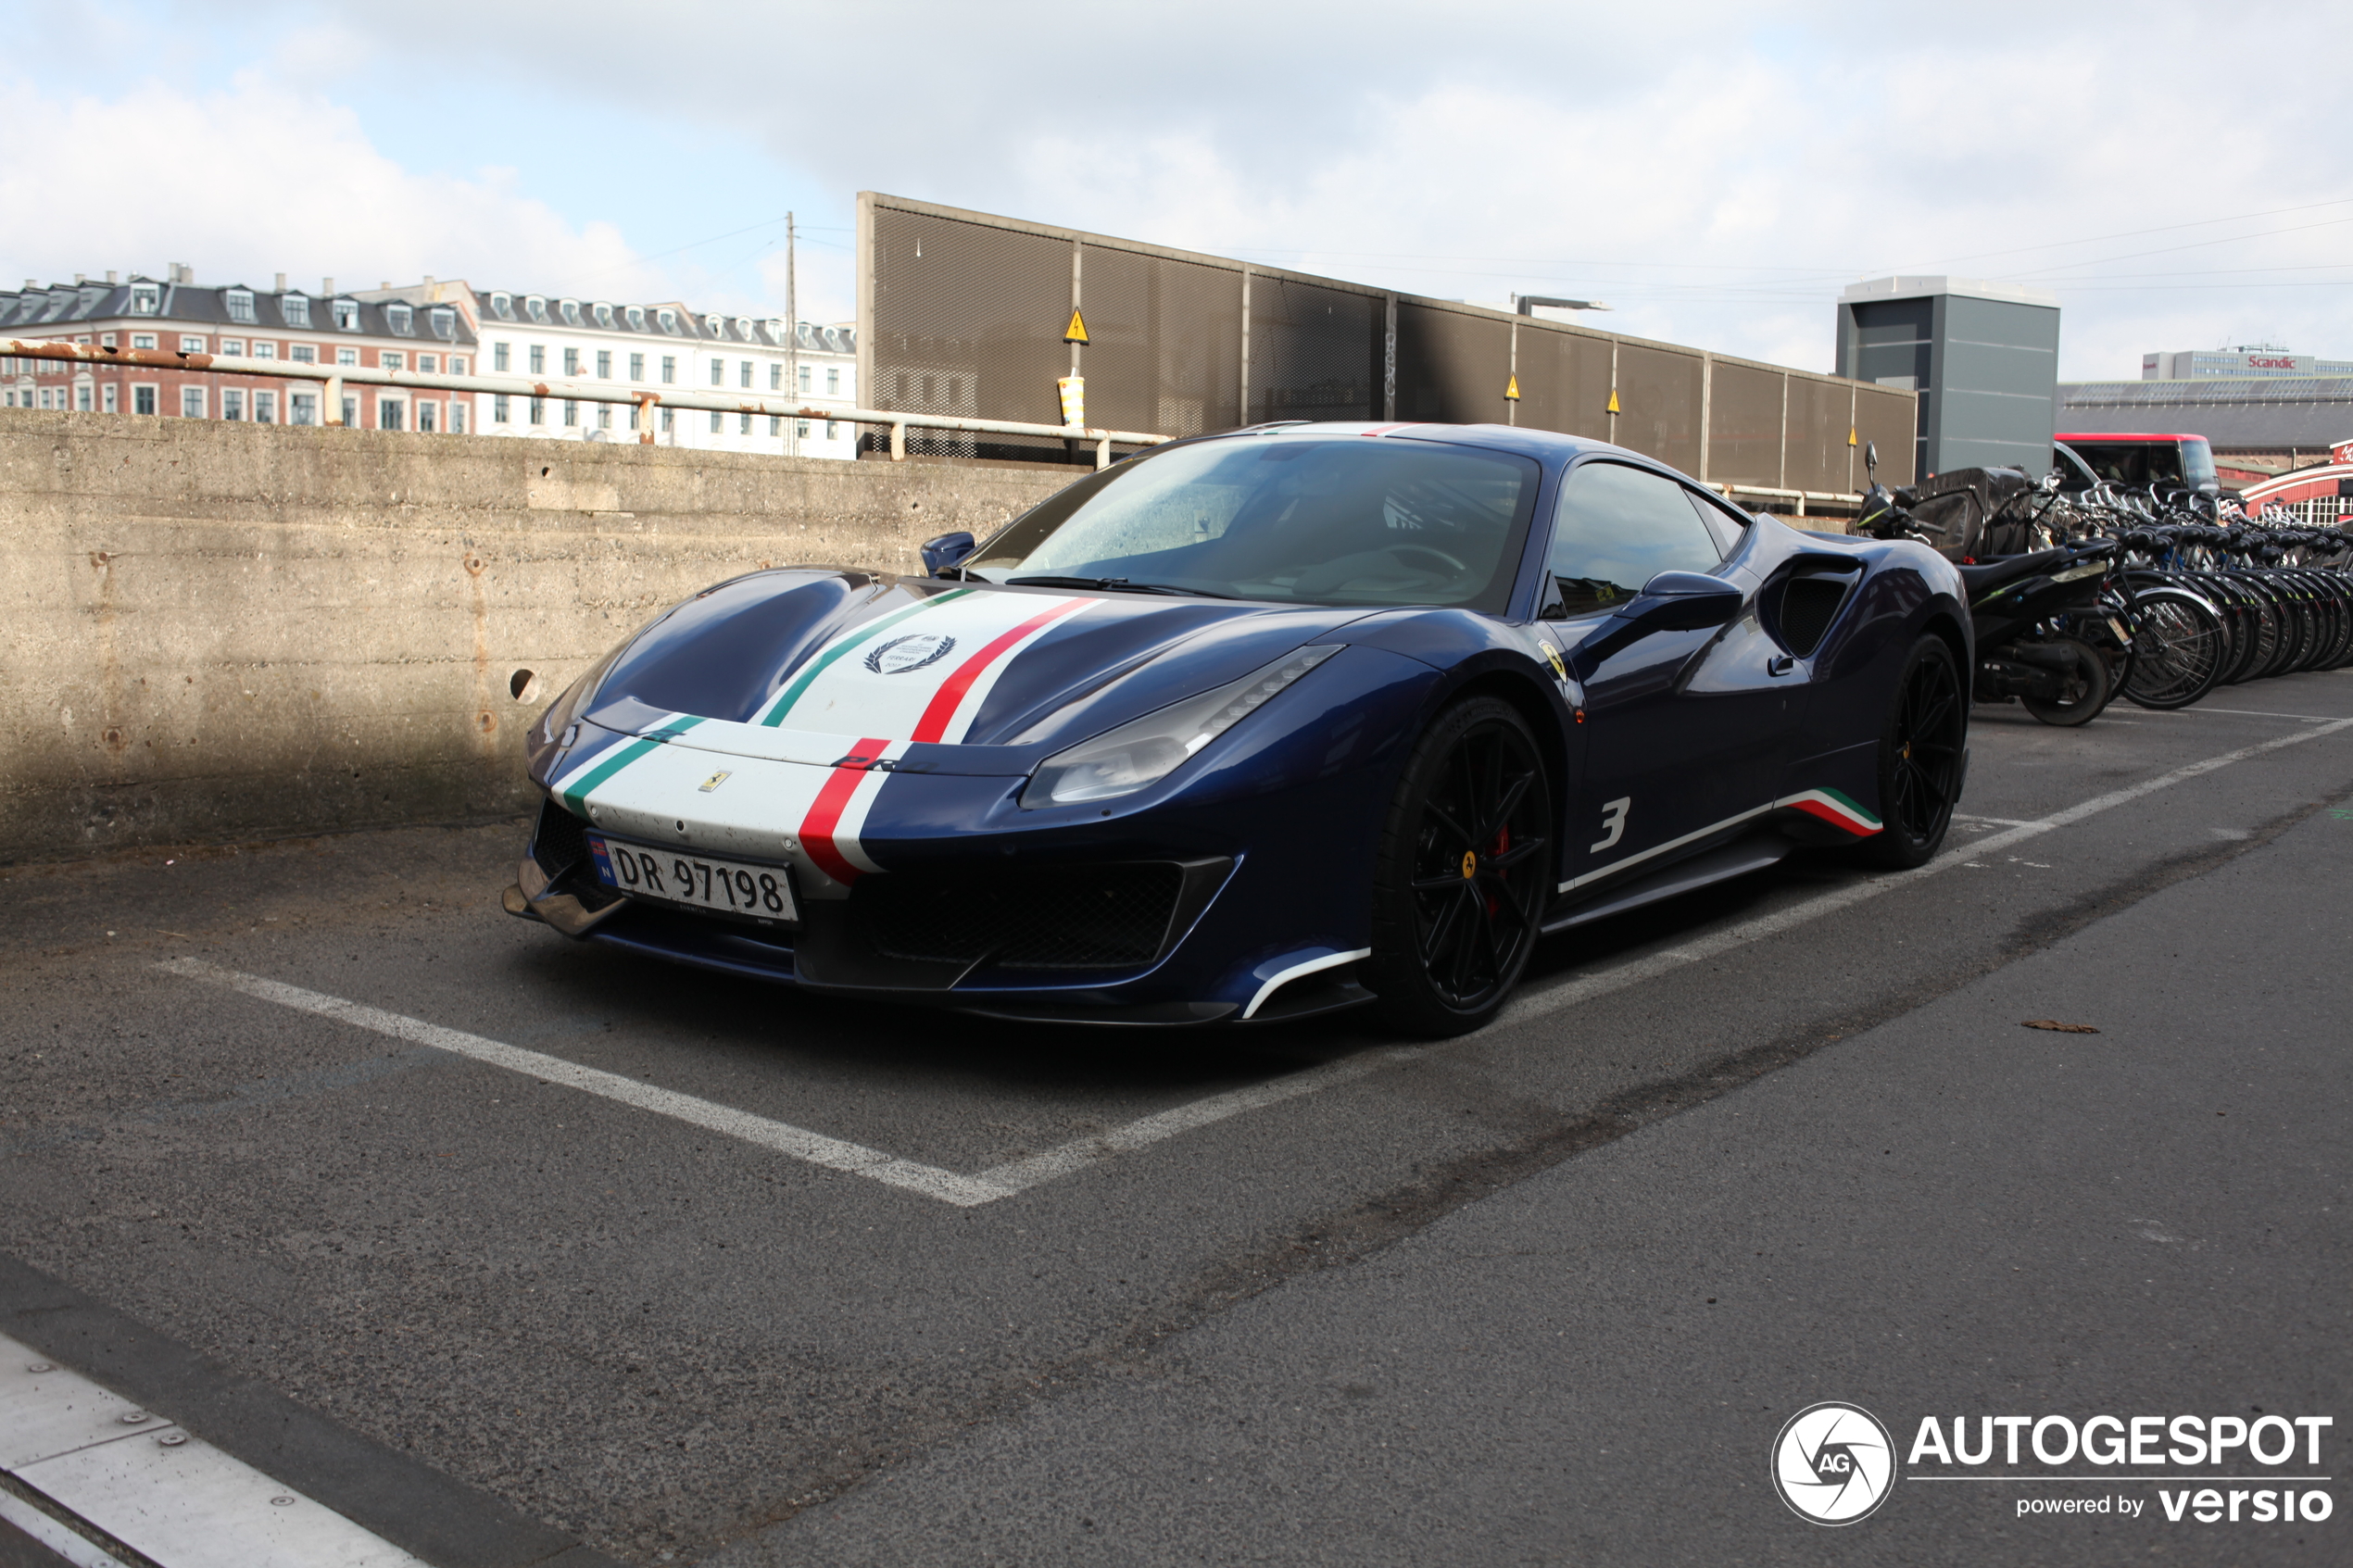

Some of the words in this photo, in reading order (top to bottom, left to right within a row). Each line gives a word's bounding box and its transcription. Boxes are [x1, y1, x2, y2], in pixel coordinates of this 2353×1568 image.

[2248, 356, 2296, 370] Scandic
[1591, 797, 1630, 854] 3
[602, 866, 611, 879] N
[615, 847, 664, 892] DR
[674, 859, 783, 912] 97198
